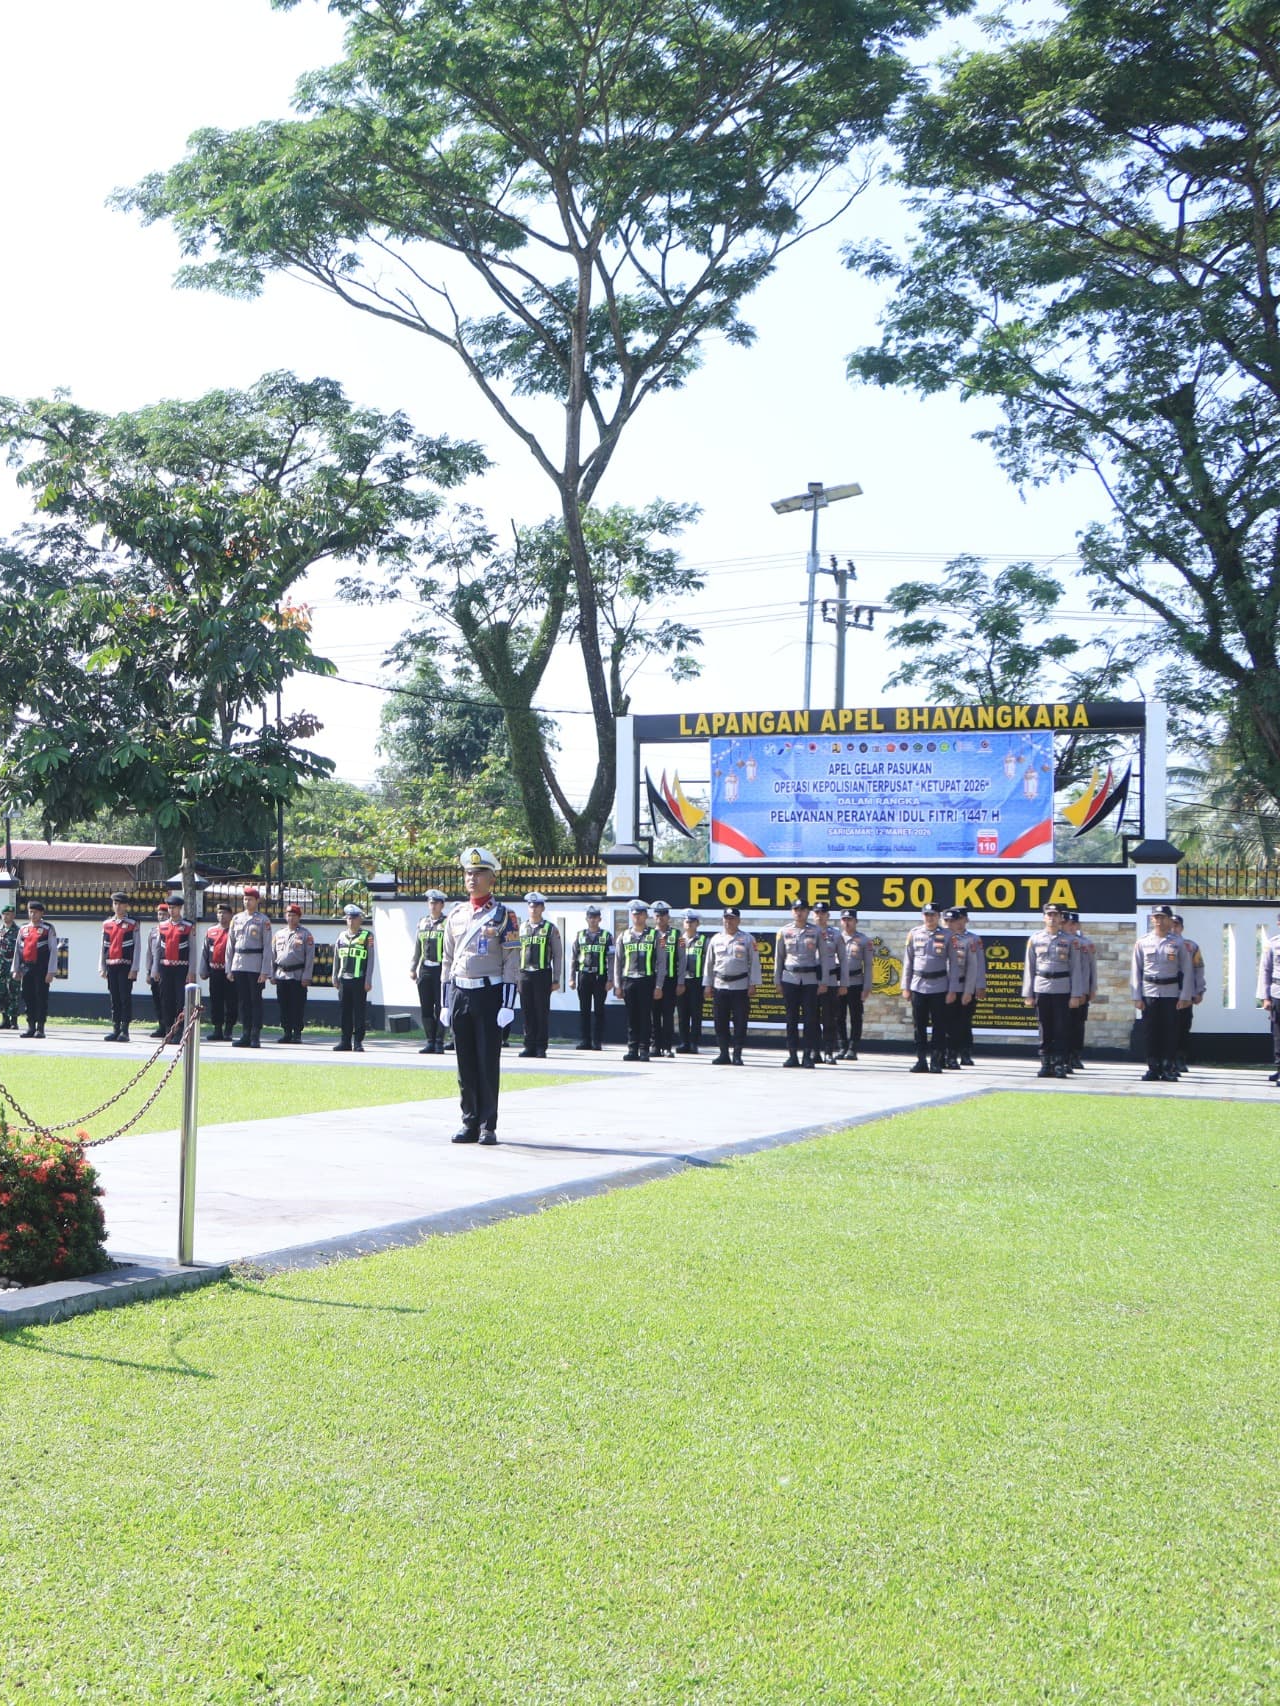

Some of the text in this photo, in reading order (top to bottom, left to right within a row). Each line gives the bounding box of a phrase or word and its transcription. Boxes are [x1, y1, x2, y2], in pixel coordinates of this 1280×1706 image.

[679, 703, 1089, 736] LAPANGAN APEL BHAYANGKARA
[828, 762, 932, 775] APEL GELAR PASUKAN
[774, 781, 810, 793] OPERASI
[812, 780, 865, 793] KEPOLISIAN
[867, 780, 913, 793] TERPUSAT
[837, 797, 920, 806] DALAM RANGKA
[770, 810, 1000, 823] PELAYANAN PERAYAAN IDUL FITRI 1447 H
[978, 842, 997, 851] 110
[689, 876, 1078, 909] POLRES 50 KOTA
